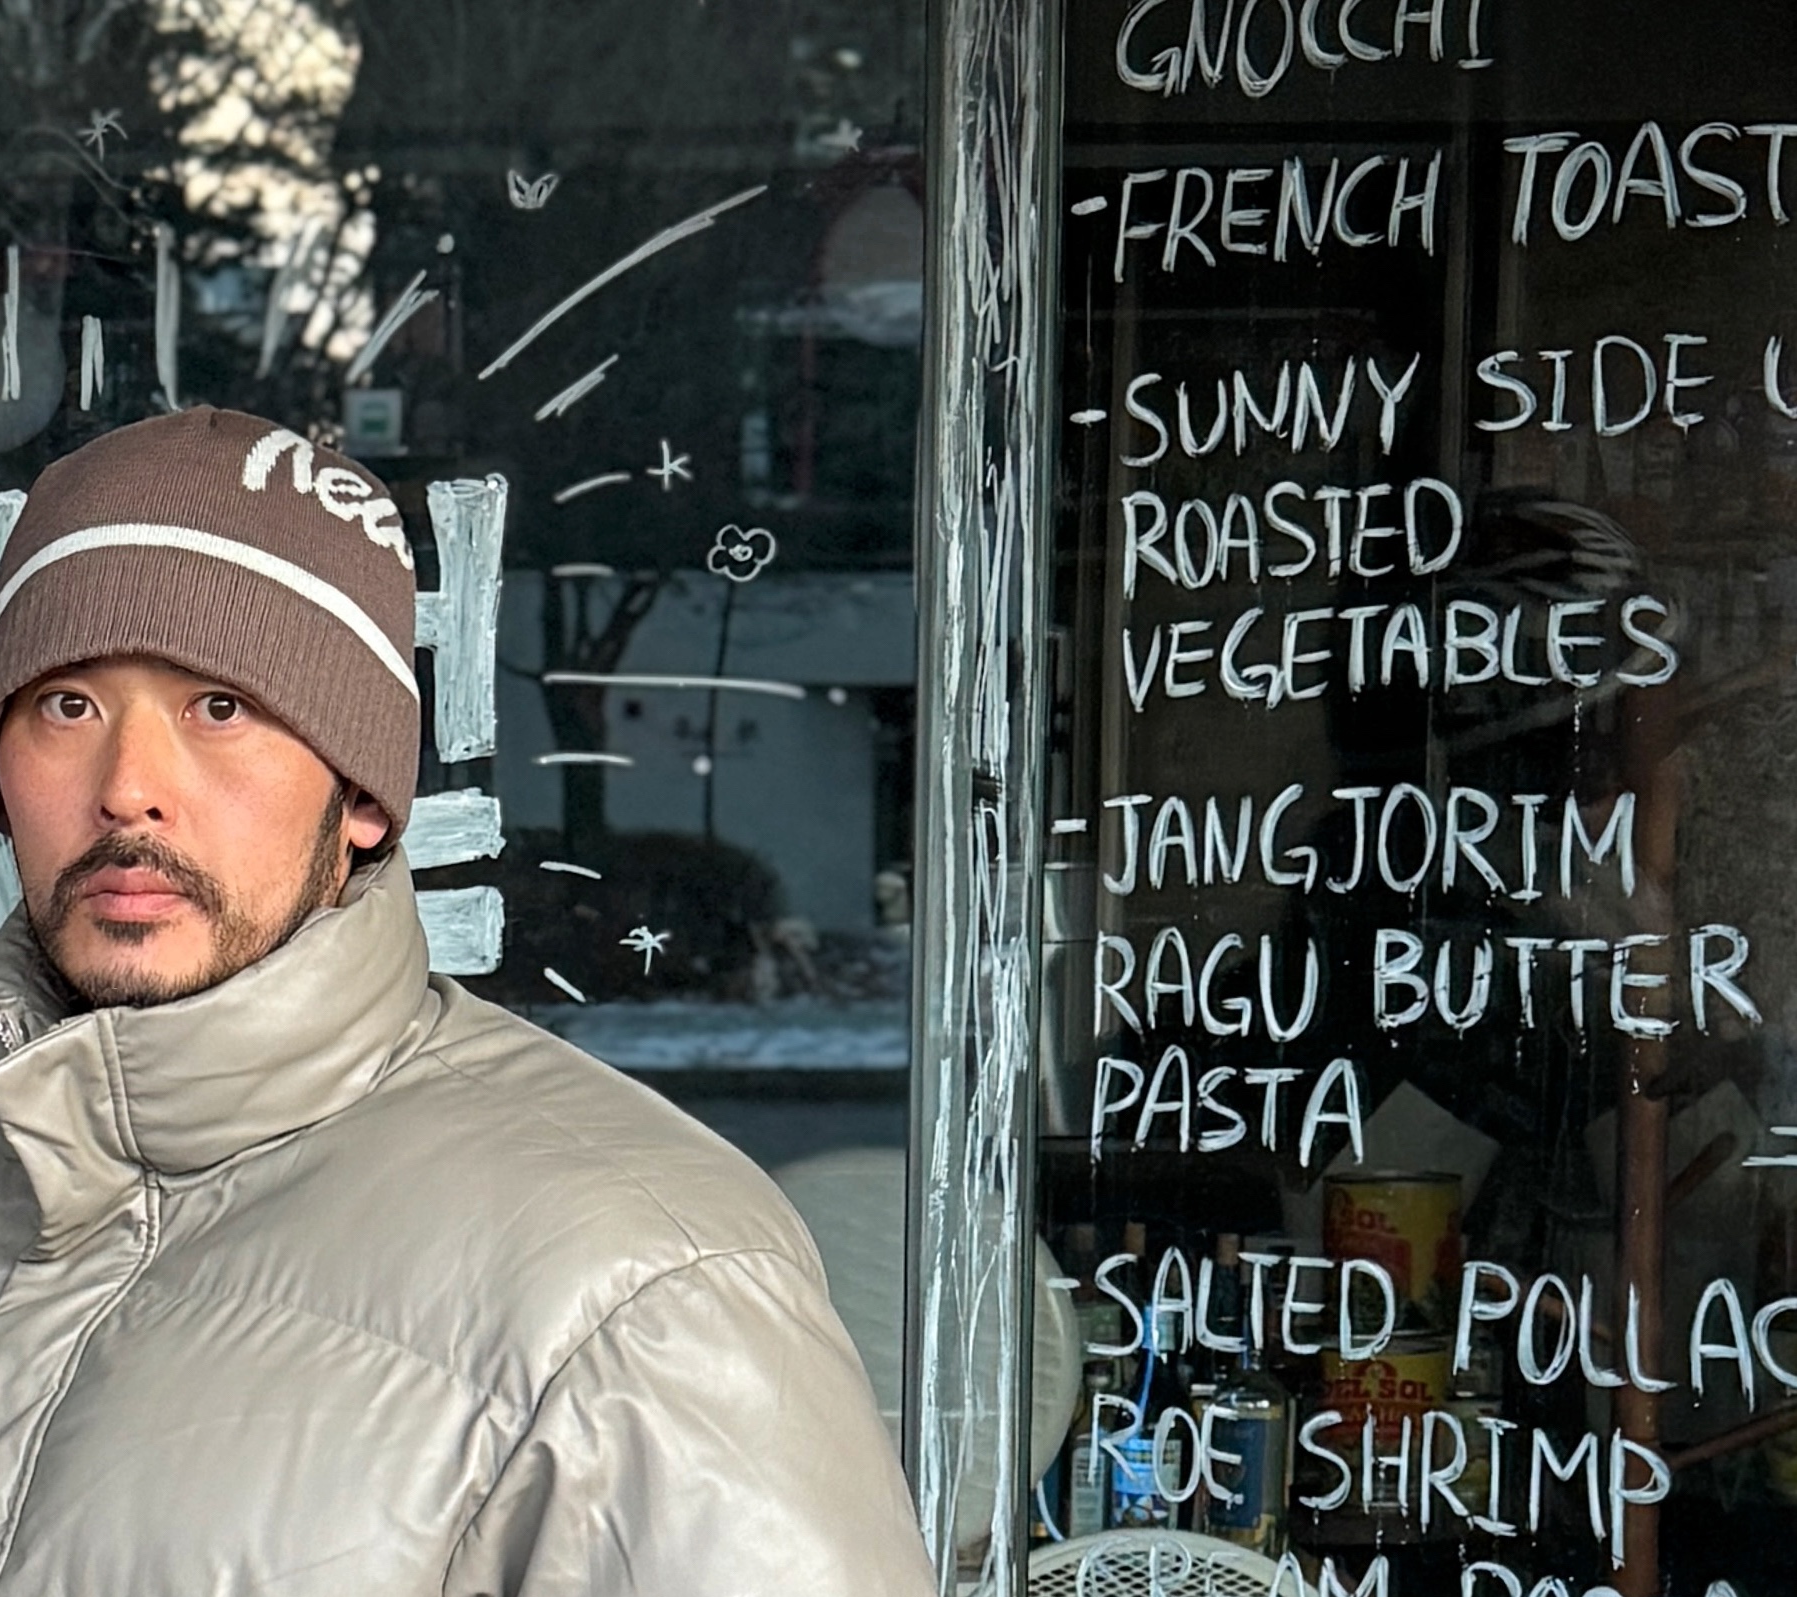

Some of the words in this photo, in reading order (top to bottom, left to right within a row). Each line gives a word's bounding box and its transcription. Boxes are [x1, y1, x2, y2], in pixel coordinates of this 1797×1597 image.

[1502, 120, 1797, 247] TOAST
[1474, 332, 1715, 438] SIDE
[1120, 477, 1464, 600] ROASTED
[1122, 595, 1680, 713] VEGETABLES
[1094, 926, 1319, 1043] RAGU
[1374, 924, 1763, 1039] BUTTER
[1090, 1045, 1364, 1168] PASTA
[1087, 1392, 1245, 1506] ROE
[1299, 1409, 1672, 1569] SHRIMP
